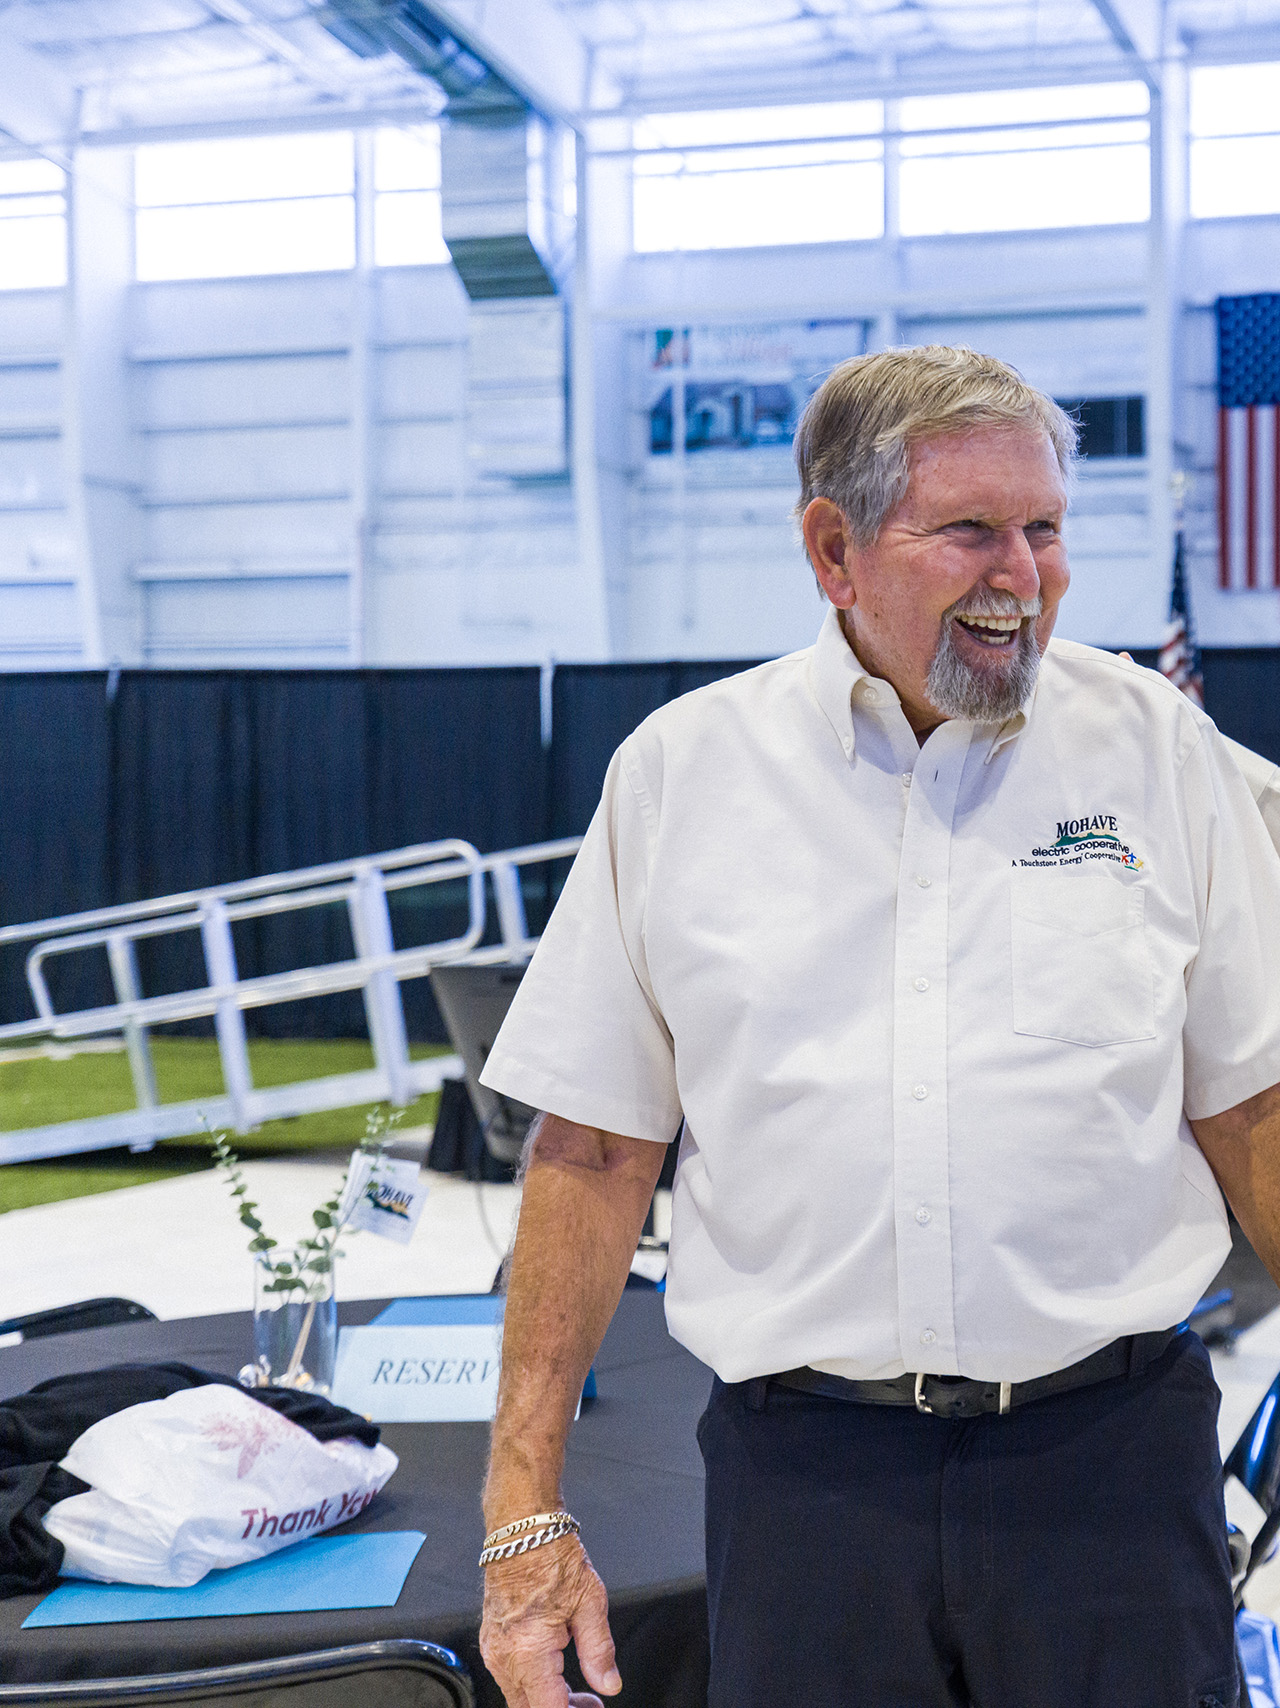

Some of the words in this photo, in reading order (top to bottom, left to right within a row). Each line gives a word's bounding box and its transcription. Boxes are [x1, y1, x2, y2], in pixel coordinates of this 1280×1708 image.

[1056, 814, 1118, 838] MOHAVE
[1031, 844, 1071, 857] electric
[1073, 838, 1131, 855] cooperative
[1011, 859, 1018, 868] A
[1019, 859, 1058, 868] Touchstone
[1059, 855, 1083, 867] Energy
[1084, 851, 1122, 864] Cooperative
[240, 1498, 335, 1540] Thank
